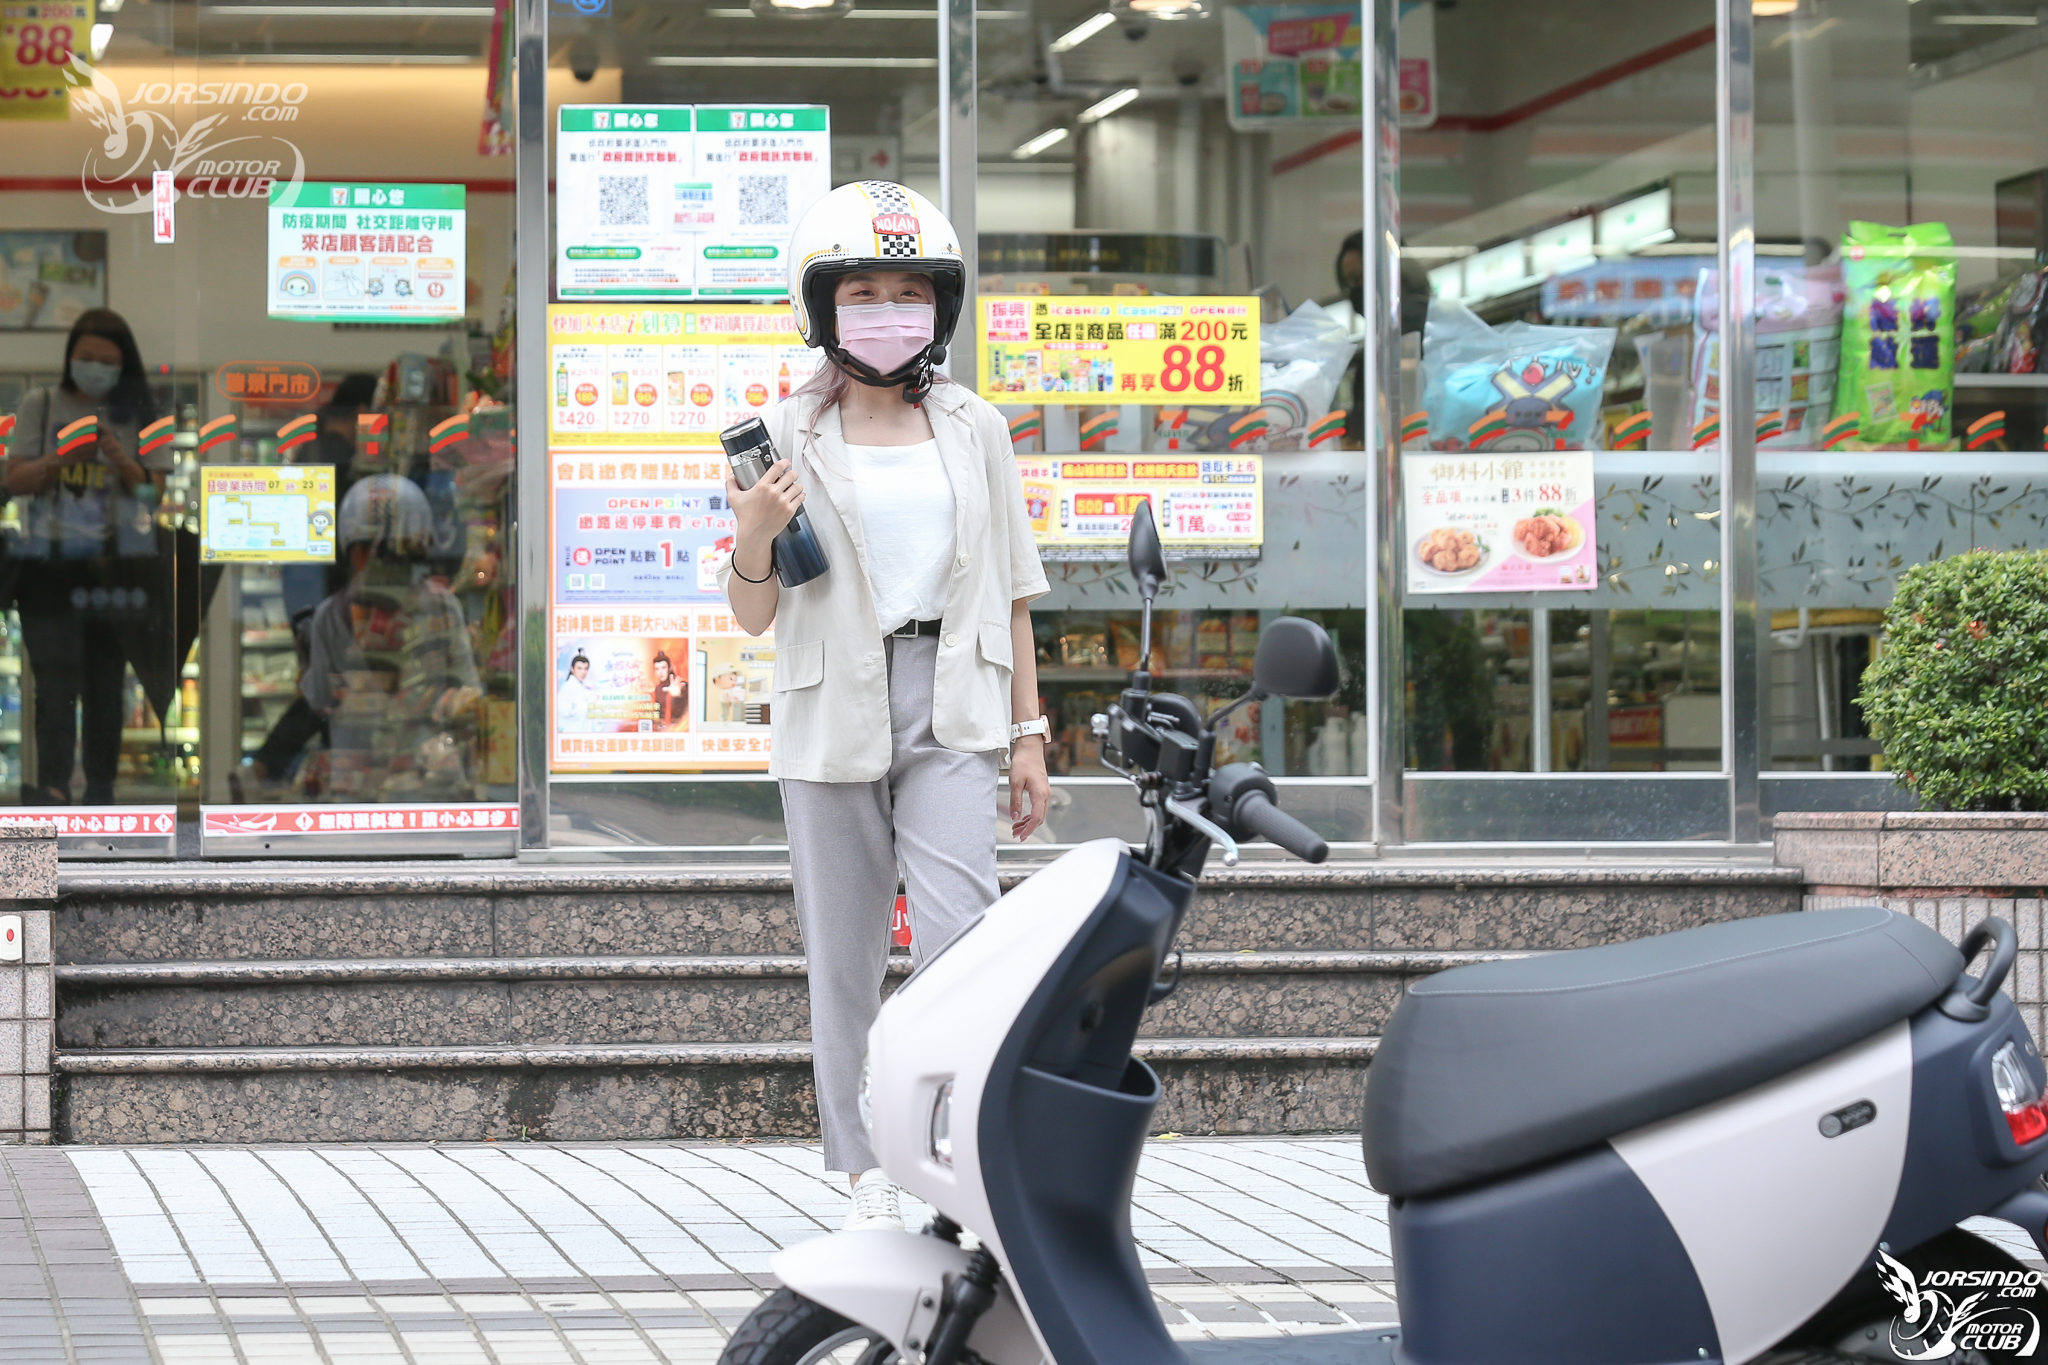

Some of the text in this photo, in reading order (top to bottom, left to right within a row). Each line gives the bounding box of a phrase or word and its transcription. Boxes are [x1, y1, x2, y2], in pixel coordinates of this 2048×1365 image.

[283, 214, 452, 231] 防疫期間 社交距離守則
[875, 216, 916, 232] NOLAN
[302, 234, 433, 253] 來店顧客請配合
[609, 499, 649, 508] OPEN
